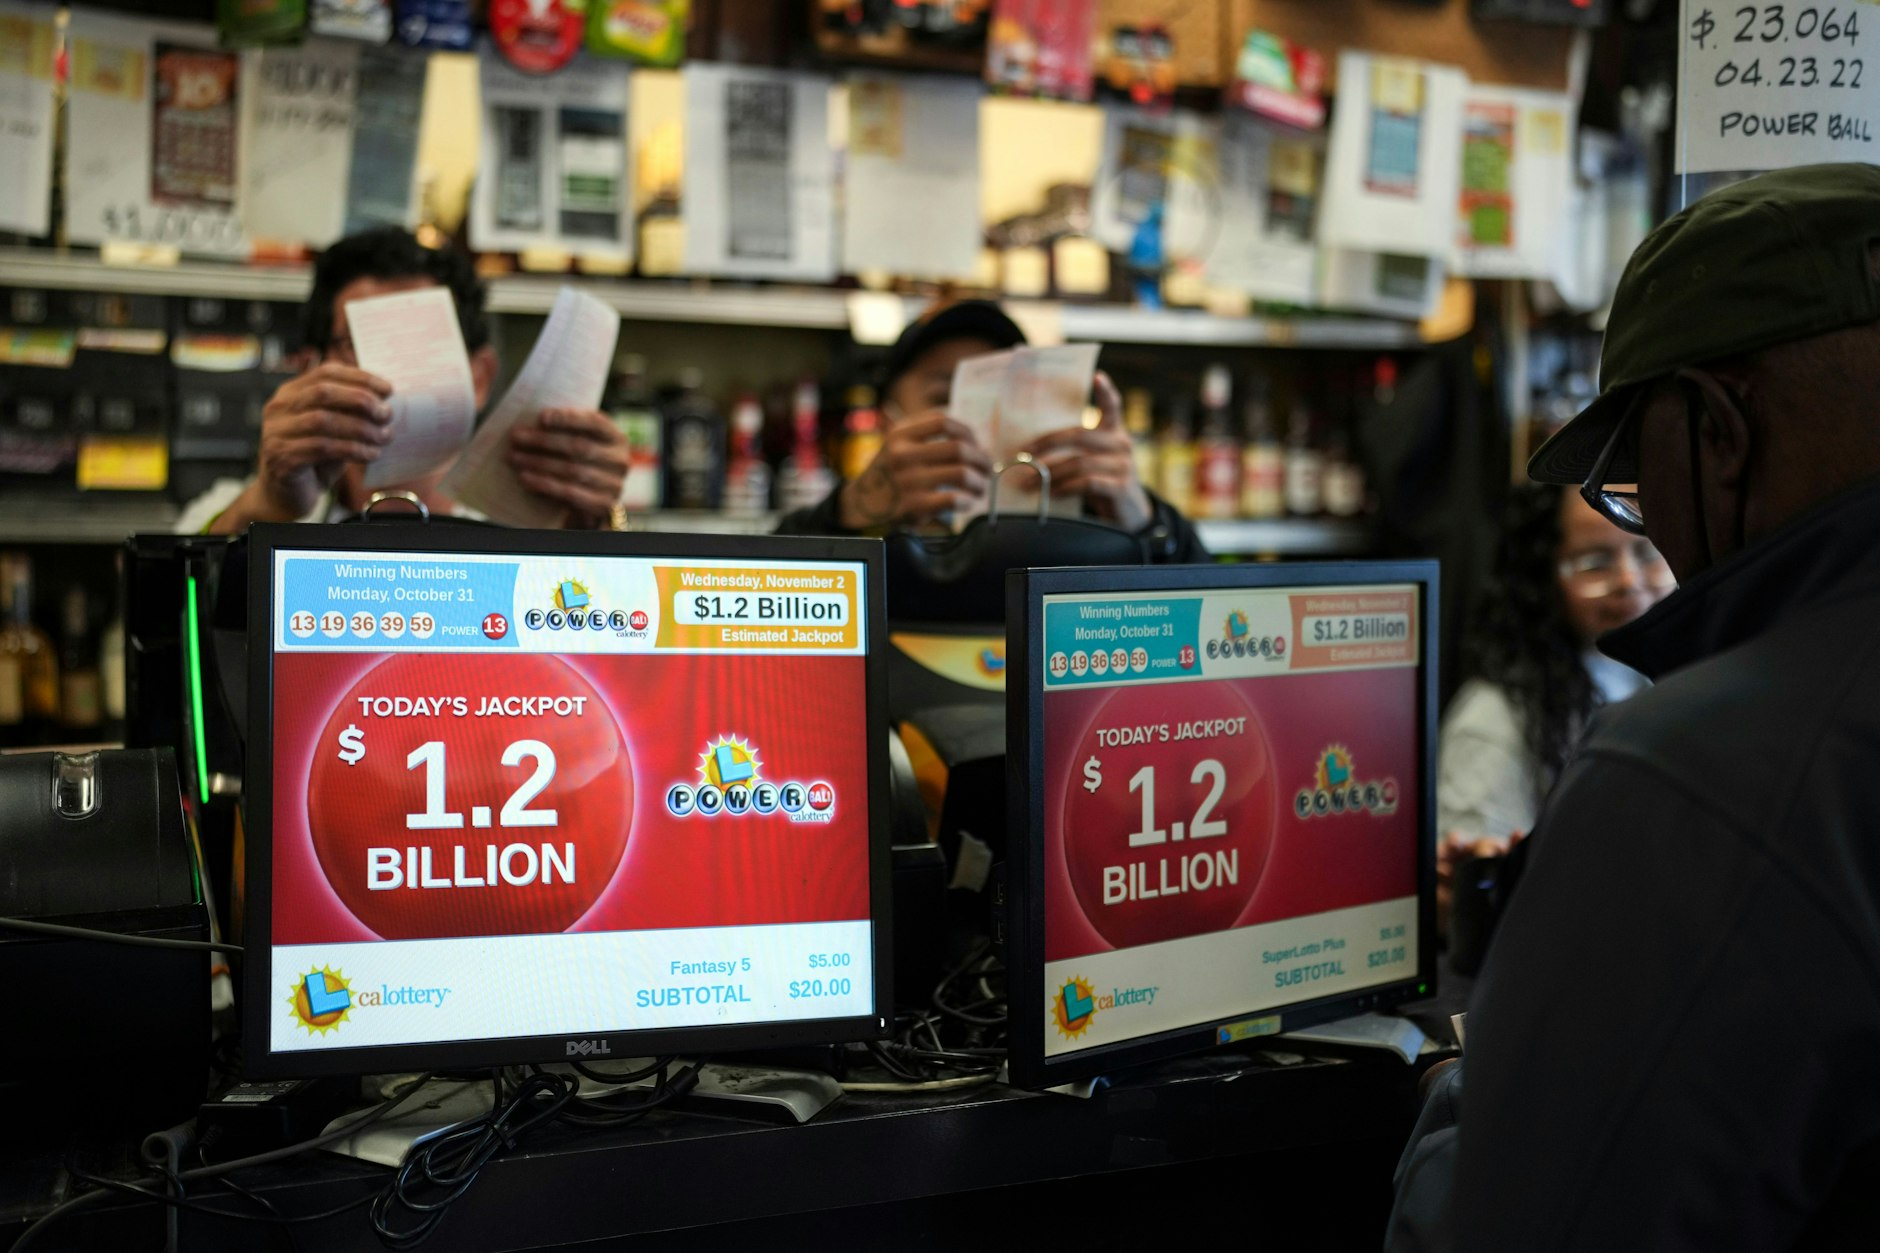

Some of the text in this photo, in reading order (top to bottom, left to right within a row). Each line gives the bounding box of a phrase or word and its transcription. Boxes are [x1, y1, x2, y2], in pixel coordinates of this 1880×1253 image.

[1734, 5, 1860, 46] 23.064
[1715, 57, 1863, 88] 04.23.22
[1720, 112, 1872, 142] POWER BALL
[334, 564, 468, 581] Winning Numbers
[681, 572, 845, 590] Wednesday, November 2
[328, 586, 474, 602] Monday, October 31
[694, 595, 842, 621] $1.2 Billion
[1080, 604, 1169, 620] Winning Numbers
[292, 615, 434, 632] 13 19 36 39 59
[442, 617, 506, 636] POWER 13
[616, 630, 648, 640] calottery
[1075, 623, 1174, 641] Monday, October 31
[1314, 618, 1405, 641] $1.2 Billion
[722, 629, 844, 645] Estimated Jackpot
[1051, 652, 1147, 671] 13 19 36 39 59
[1151, 649, 1194, 668] POWER 13
[358, 696, 587, 718] TODAY'S JACKPOT
[1096, 717, 1247, 747] TODAY'S JACKPOT
[337, 724, 558, 830] $ 1.2
[1082, 756, 1227, 848] $ 1.2
[790, 811, 833, 824] calottery
[367, 842, 576, 891] BILLION
[1103, 849, 1239, 905] BILLION
[1262, 942, 1321, 964] SuperLotto
[1323, 939, 1345, 952] Plus
[671, 953, 851, 977] Fantasy 5 $5.00
[1275, 960, 1345, 988] SUBTOTAL
[358, 984, 450, 1008] calottery
[636, 978, 851, 1008] SUBTOTAL $20.00
[1097, 986, 1159, 1010] calottery
[566, 1039, 611, 1056] DELL
